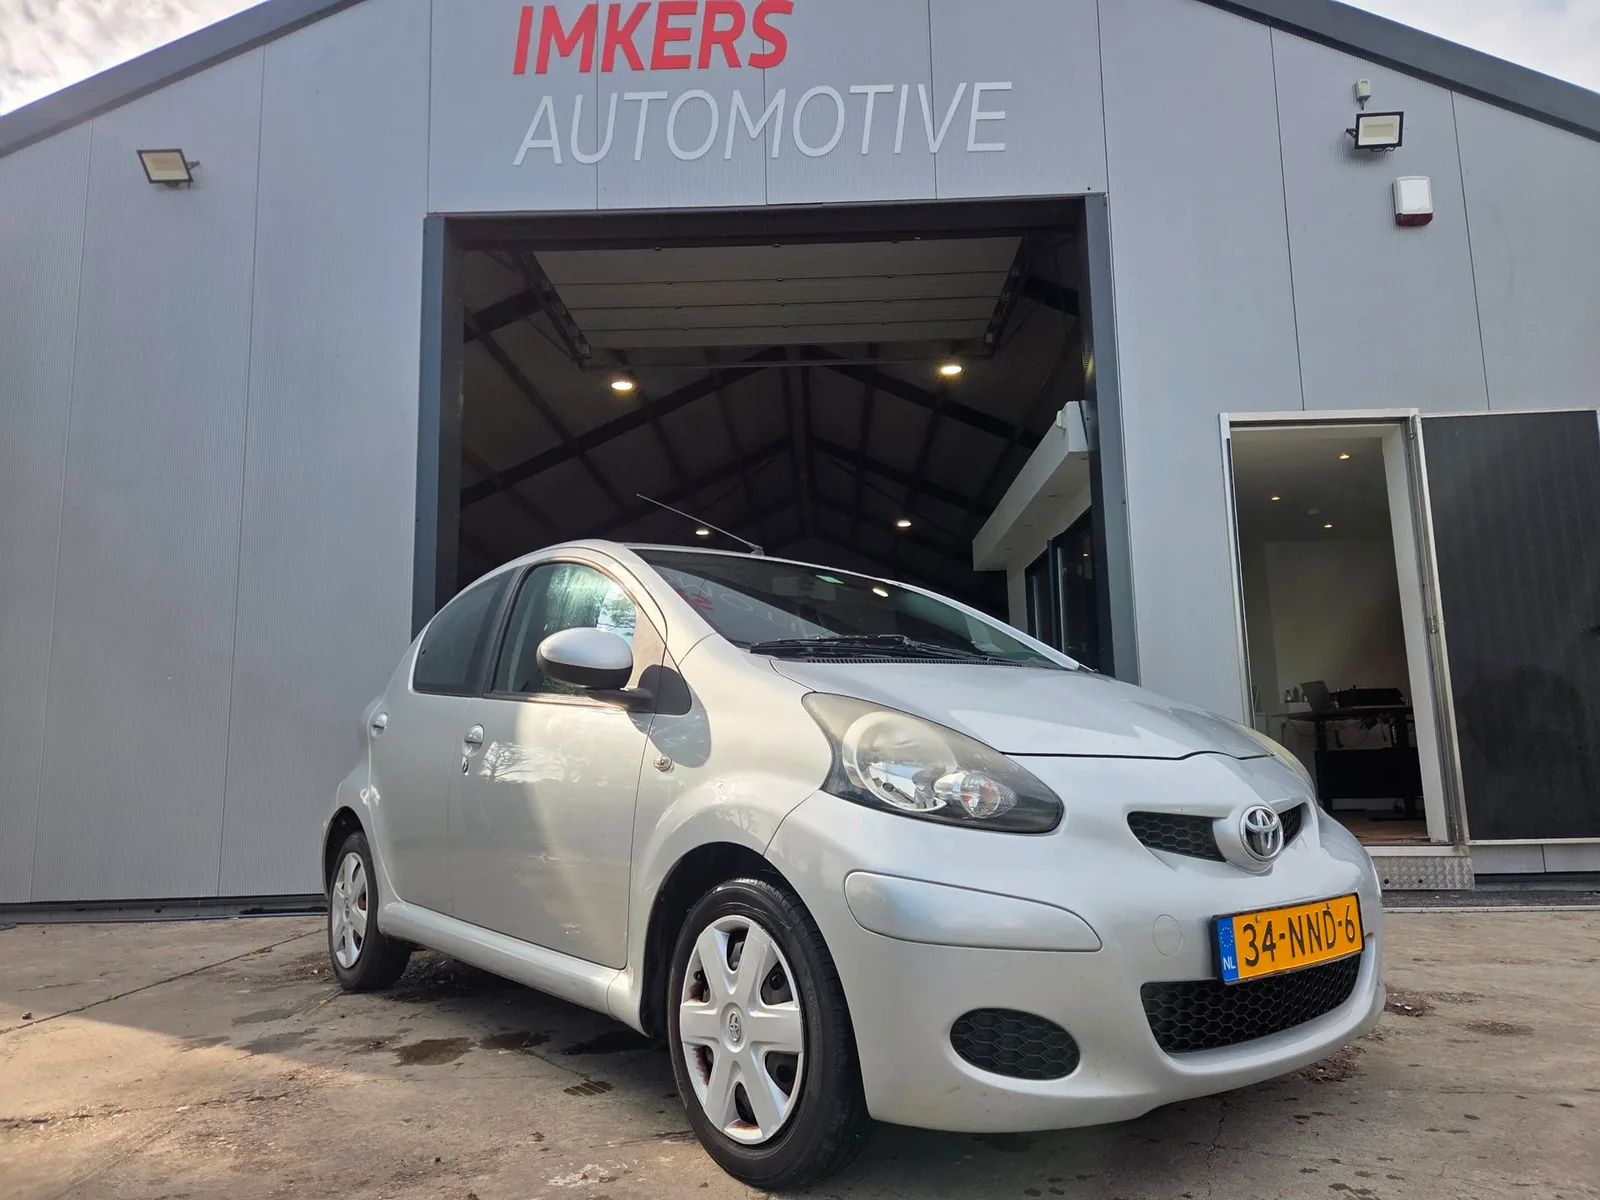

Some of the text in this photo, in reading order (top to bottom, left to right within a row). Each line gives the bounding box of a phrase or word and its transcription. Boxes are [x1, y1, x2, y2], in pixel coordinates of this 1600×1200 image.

[513, 0, 793, 74] IMKERS
[513, 82, 1012, 165] AUTOMOTIVE
[1222, 957, 1237, 971] NL
[1243, 904, 1356, 967] 34-NND-6
